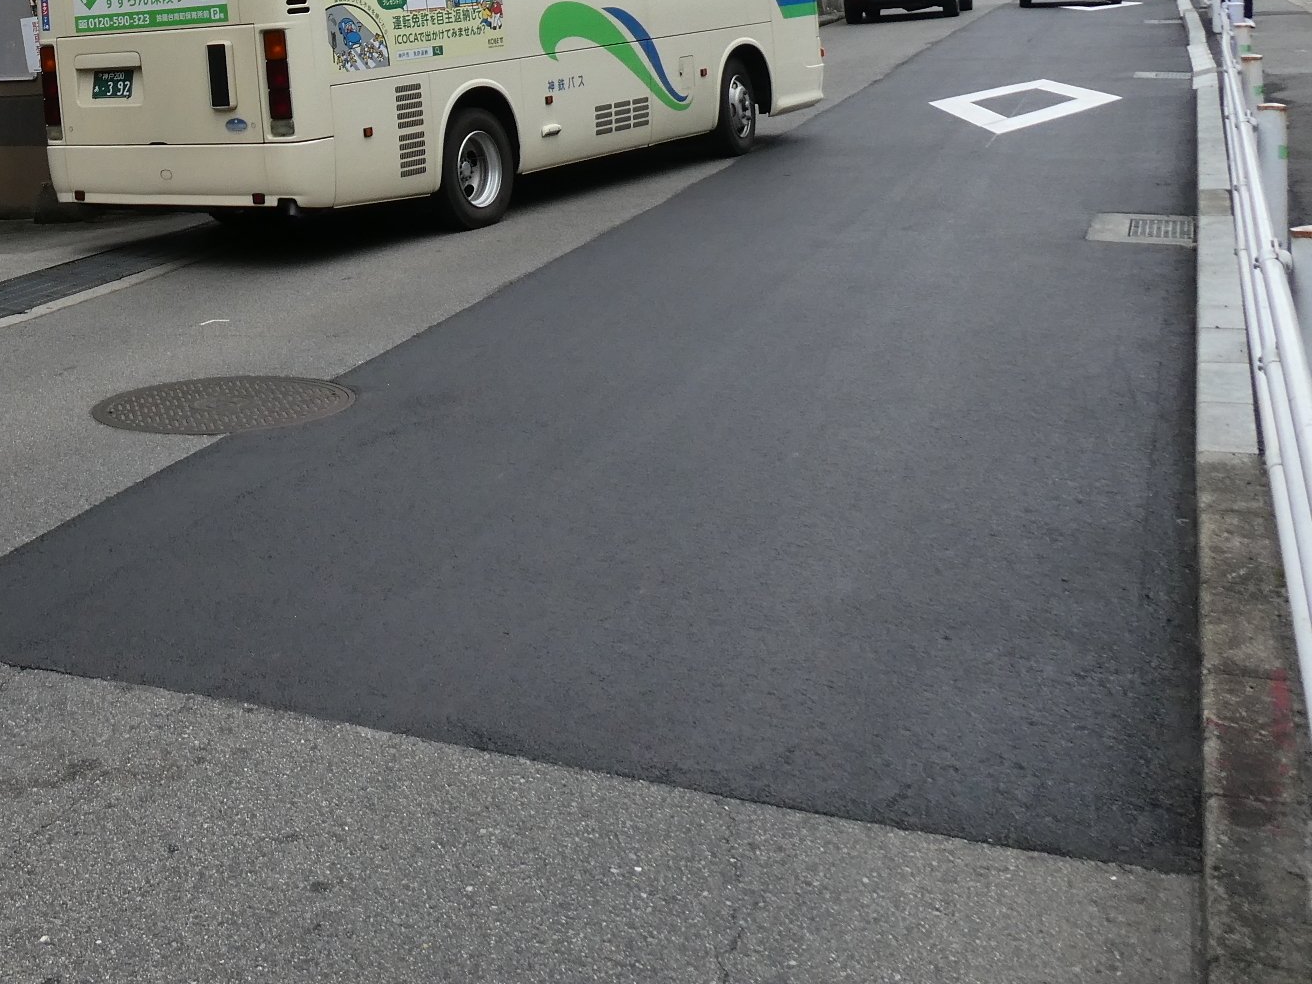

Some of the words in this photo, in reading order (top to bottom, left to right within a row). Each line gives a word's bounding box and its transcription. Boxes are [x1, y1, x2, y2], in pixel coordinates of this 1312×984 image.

[88, 14, 150, 29] 0120-590-323
[392, 8, 482, 30] 運転免許を自主返納して
[547, 75, 585, 93] 神鉄バス
